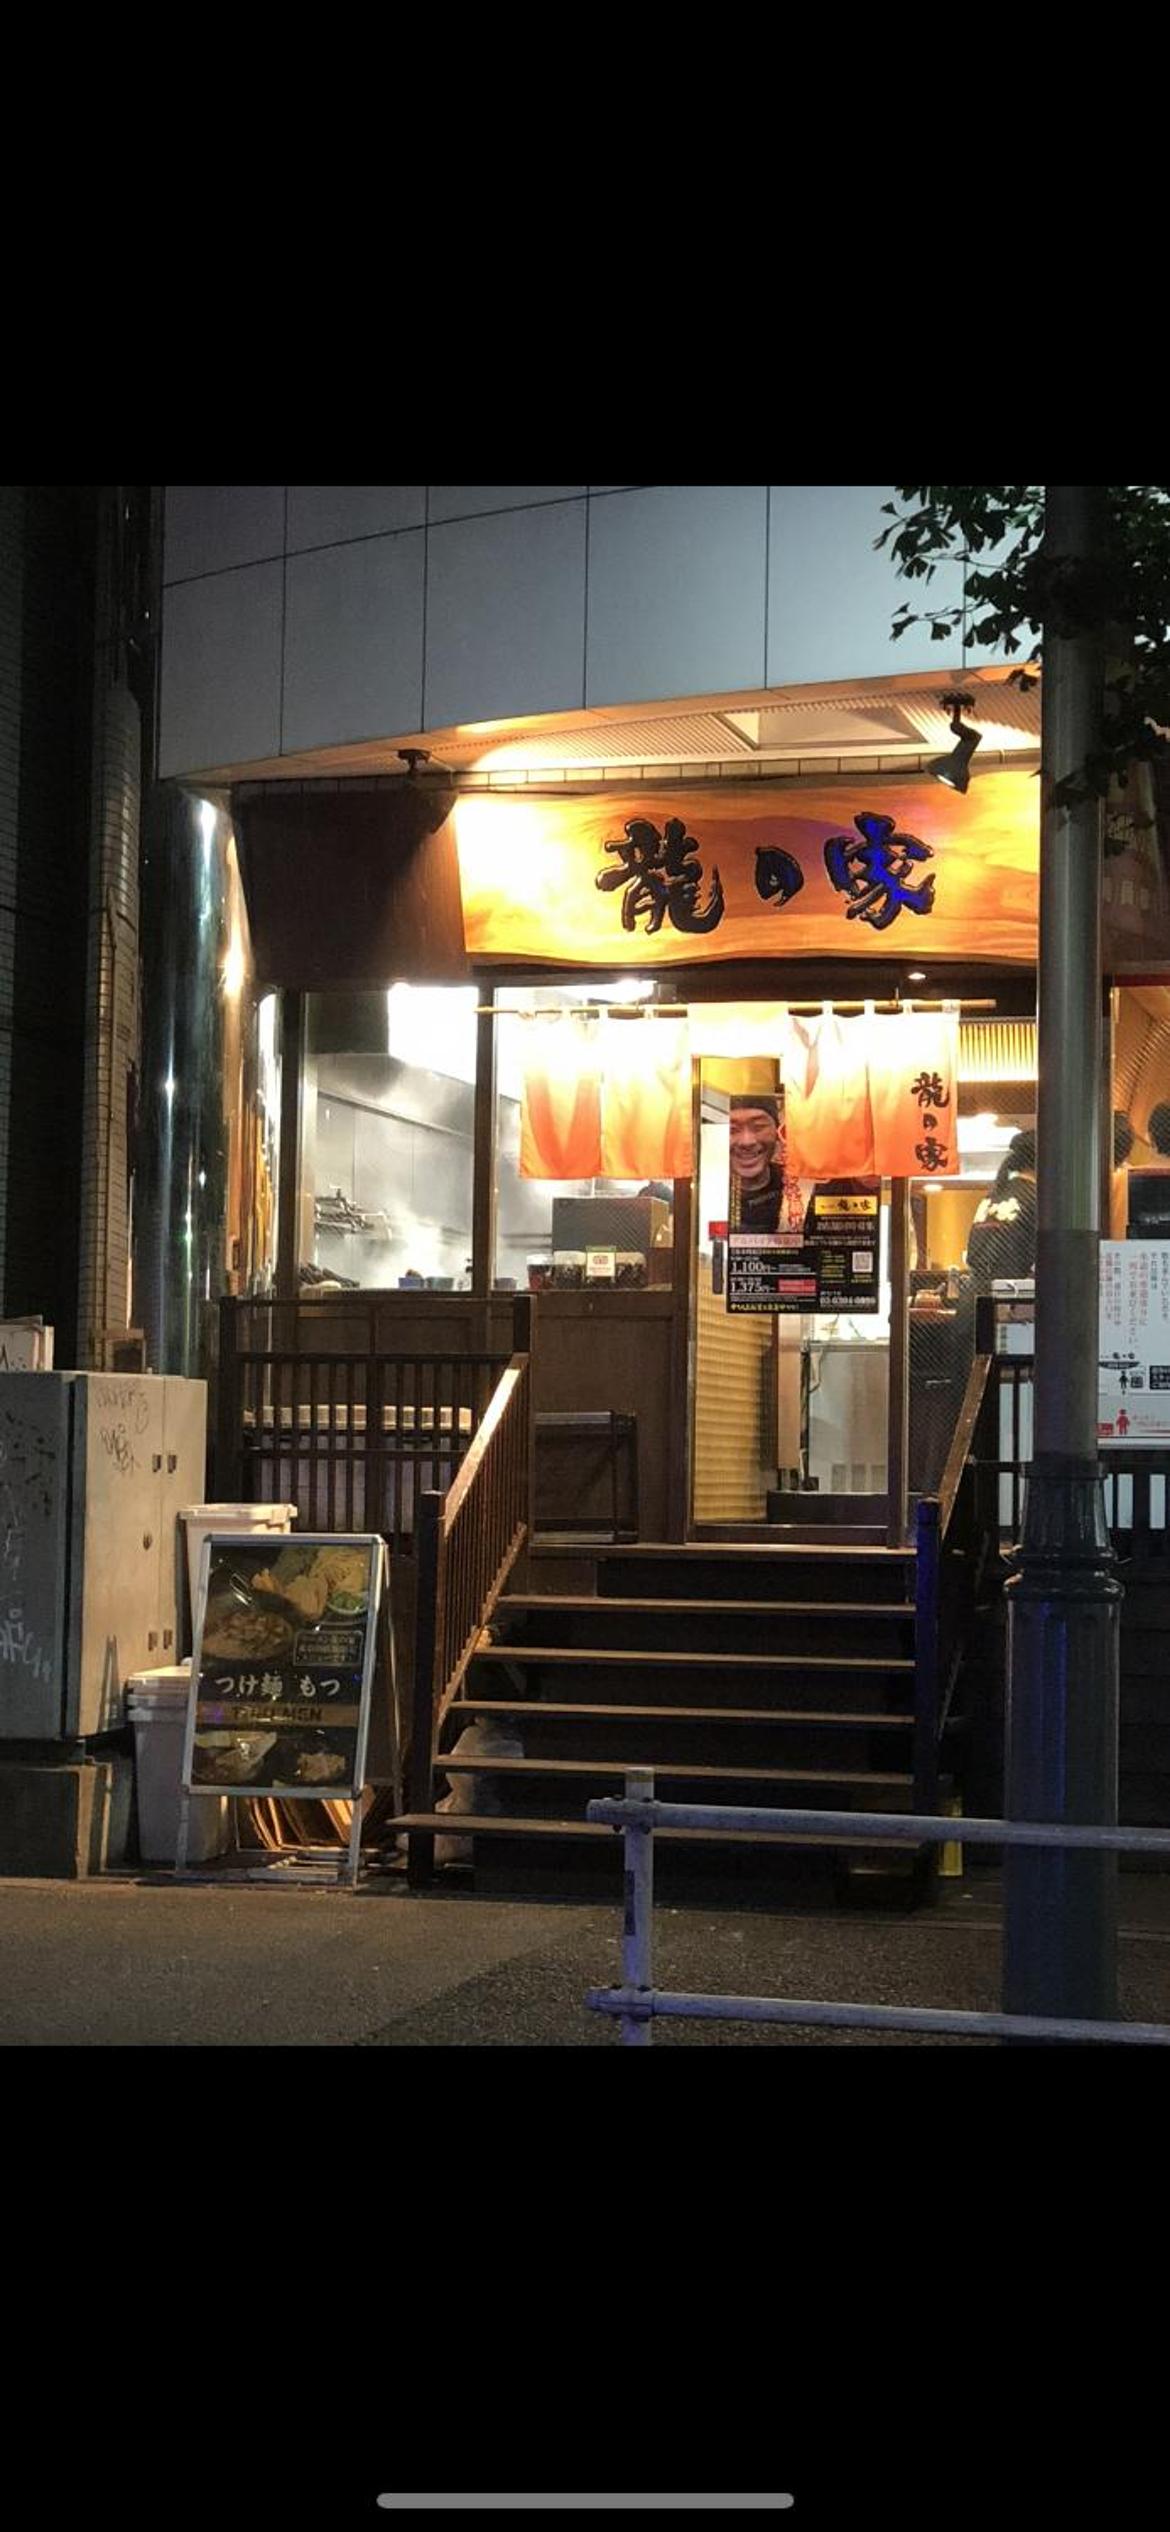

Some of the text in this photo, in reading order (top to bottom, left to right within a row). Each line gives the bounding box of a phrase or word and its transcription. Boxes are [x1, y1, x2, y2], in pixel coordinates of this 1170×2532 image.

[595, 812, 936, 934] 龍の家
[911, 1071, 950, 1172] 龍の家
[215, 1672, 341, 1697] つけ麺 もつ
